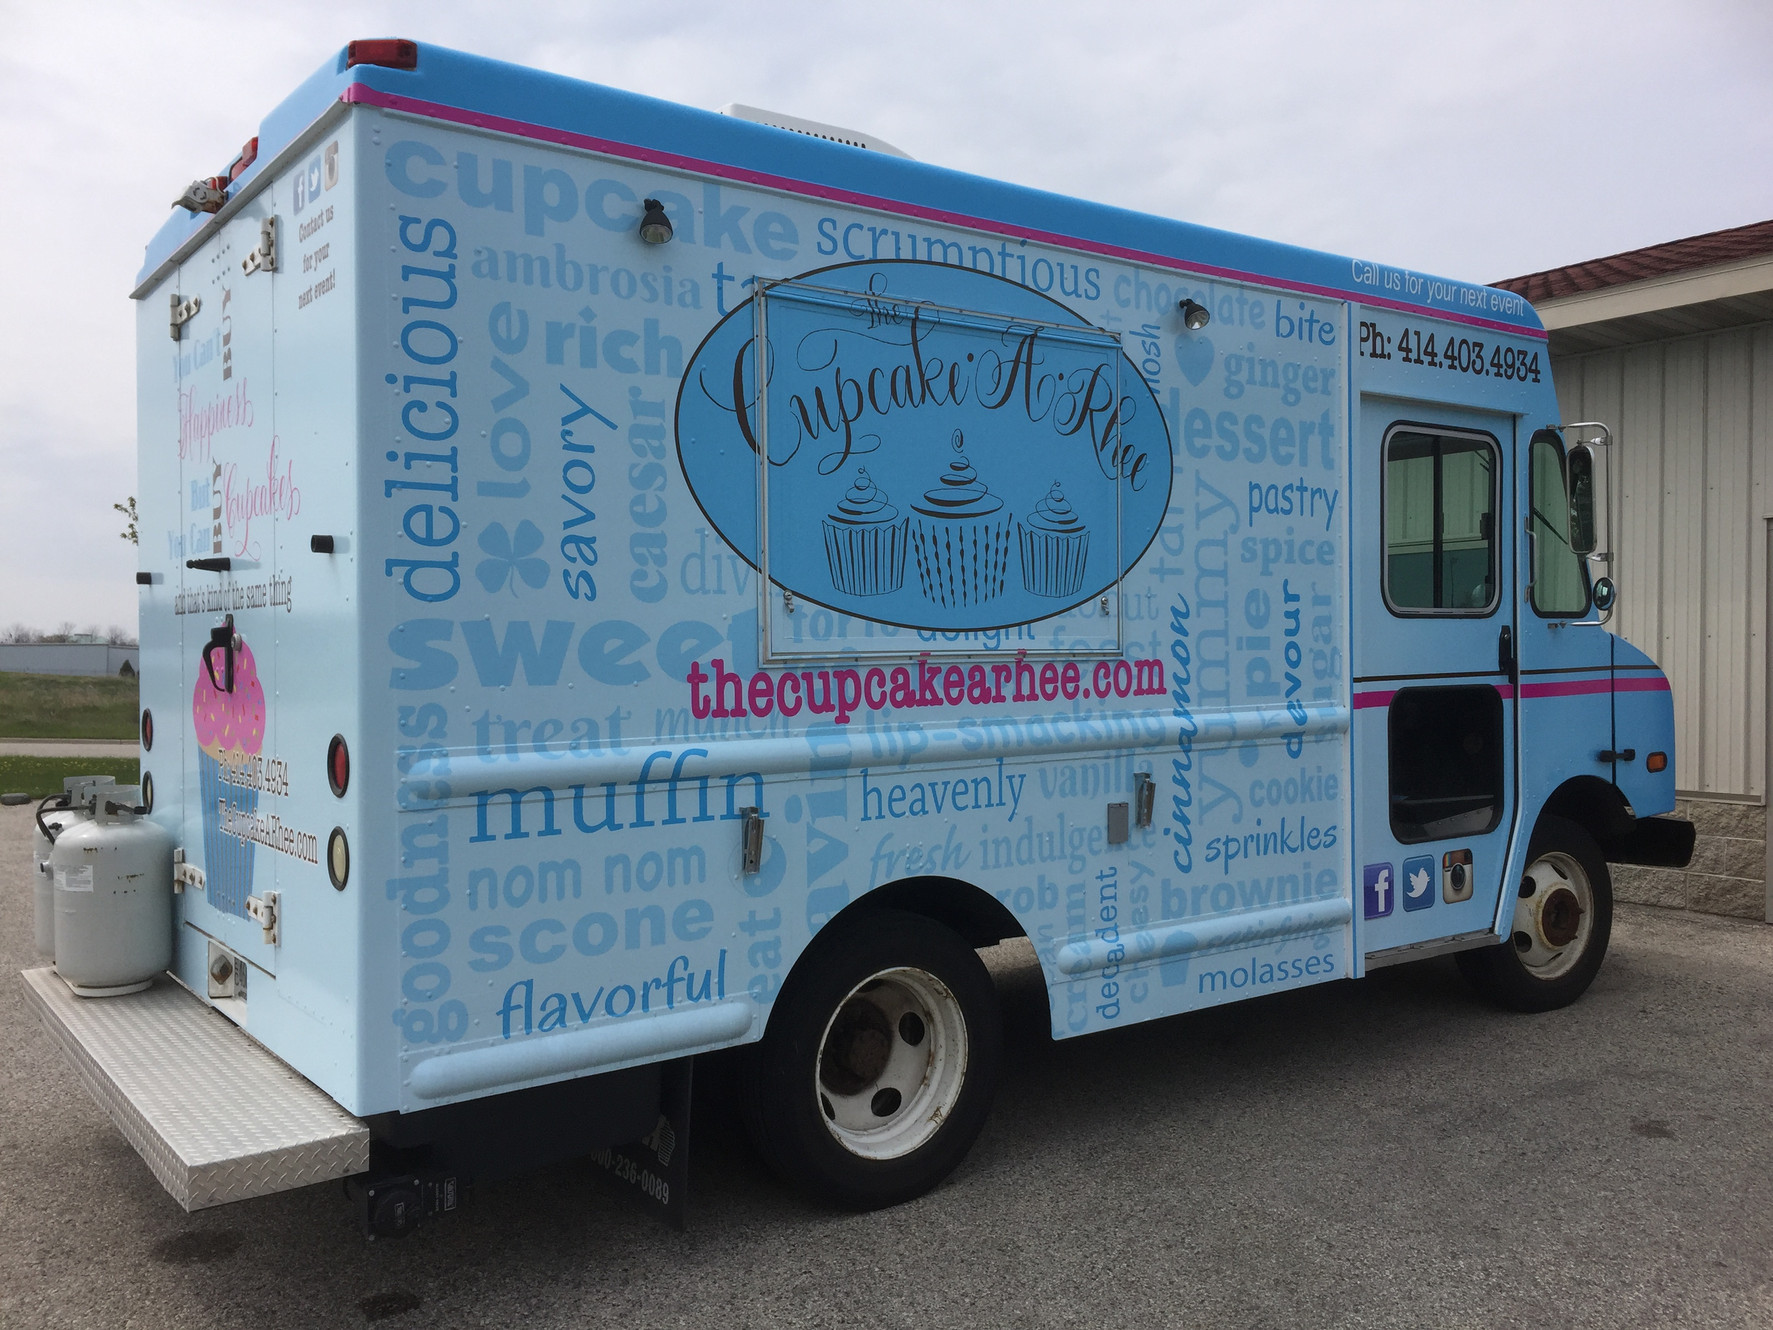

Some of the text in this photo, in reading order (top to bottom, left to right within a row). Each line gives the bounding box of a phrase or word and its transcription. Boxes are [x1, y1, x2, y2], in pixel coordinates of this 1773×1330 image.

[299, 204, 334, 243] Contact us
[385, 139, 799, 263] cupcake
[298, 268, 336, 311] next event!
[303, 242, 330, 273] for your
[470, 243, 704, 311] ambrosia
[816, 217, 1102, 301] scrumptious
[1351, 258, 1525, 317] Call us for your next event
[851, 272, 904, 330] the
[1113, 267, 1267, 330] chocolate
[1274, 299, 1336, 346] bite
[545, 305, 684, 379] rich
[1223, 341, 1336, 408] ginger
[1359, 320, 1541, 384] Ph: 414.403.4934
[384, 214, 461, 602] delicious
[475, 301, 532, 499] love
[699, 301, 972, 477] Cupcake
[1161, 387, 1335, 471] dessert
[223, 435, 301, 561] Cupcakes
[560, 383, 618, 602] savory
[627, 384, 669, 604] caesar
[1248, 476, 1338, 532] pastry
[1240, 526, 1335, 577] spice
[246, 583, 267, 609] same
[268, 574, 293, 613] thing
[388, 618, 759, 690] sweet
[1236, 588, 1281, 697] pie
[1281, 578, 1309, 759] devour
[687, 649, 1167, 724] thecupcakearhee.com
[472, 705, 632, 764] treat
[866, 695, 1167, 768] lip-smacking
[1163, 592, 1199, 874] cinnamon
[469, 748, 770, 844] muffin
[860, 757, 1027, 822] heavenly
[1250, 765, 1338, 808] cookie
[385, 702, 468, 1045] goodness
[467, 845, 708, 912] nom nom
[868, 824, 972, 892] fresh
[979, 812, 1157, 875] indulgece
[1205, 815, 1338, 876] sprinkles
[1160, 861, 1339, 921] brownie
[467, 899, 715, 973] scone
[738, 905, 782, 1005] eat
[1095, 866, 1126, 1020] decadent
[496, 949, 727, 1040] flavorful
[1198, 953, 1336, 994] molasses
